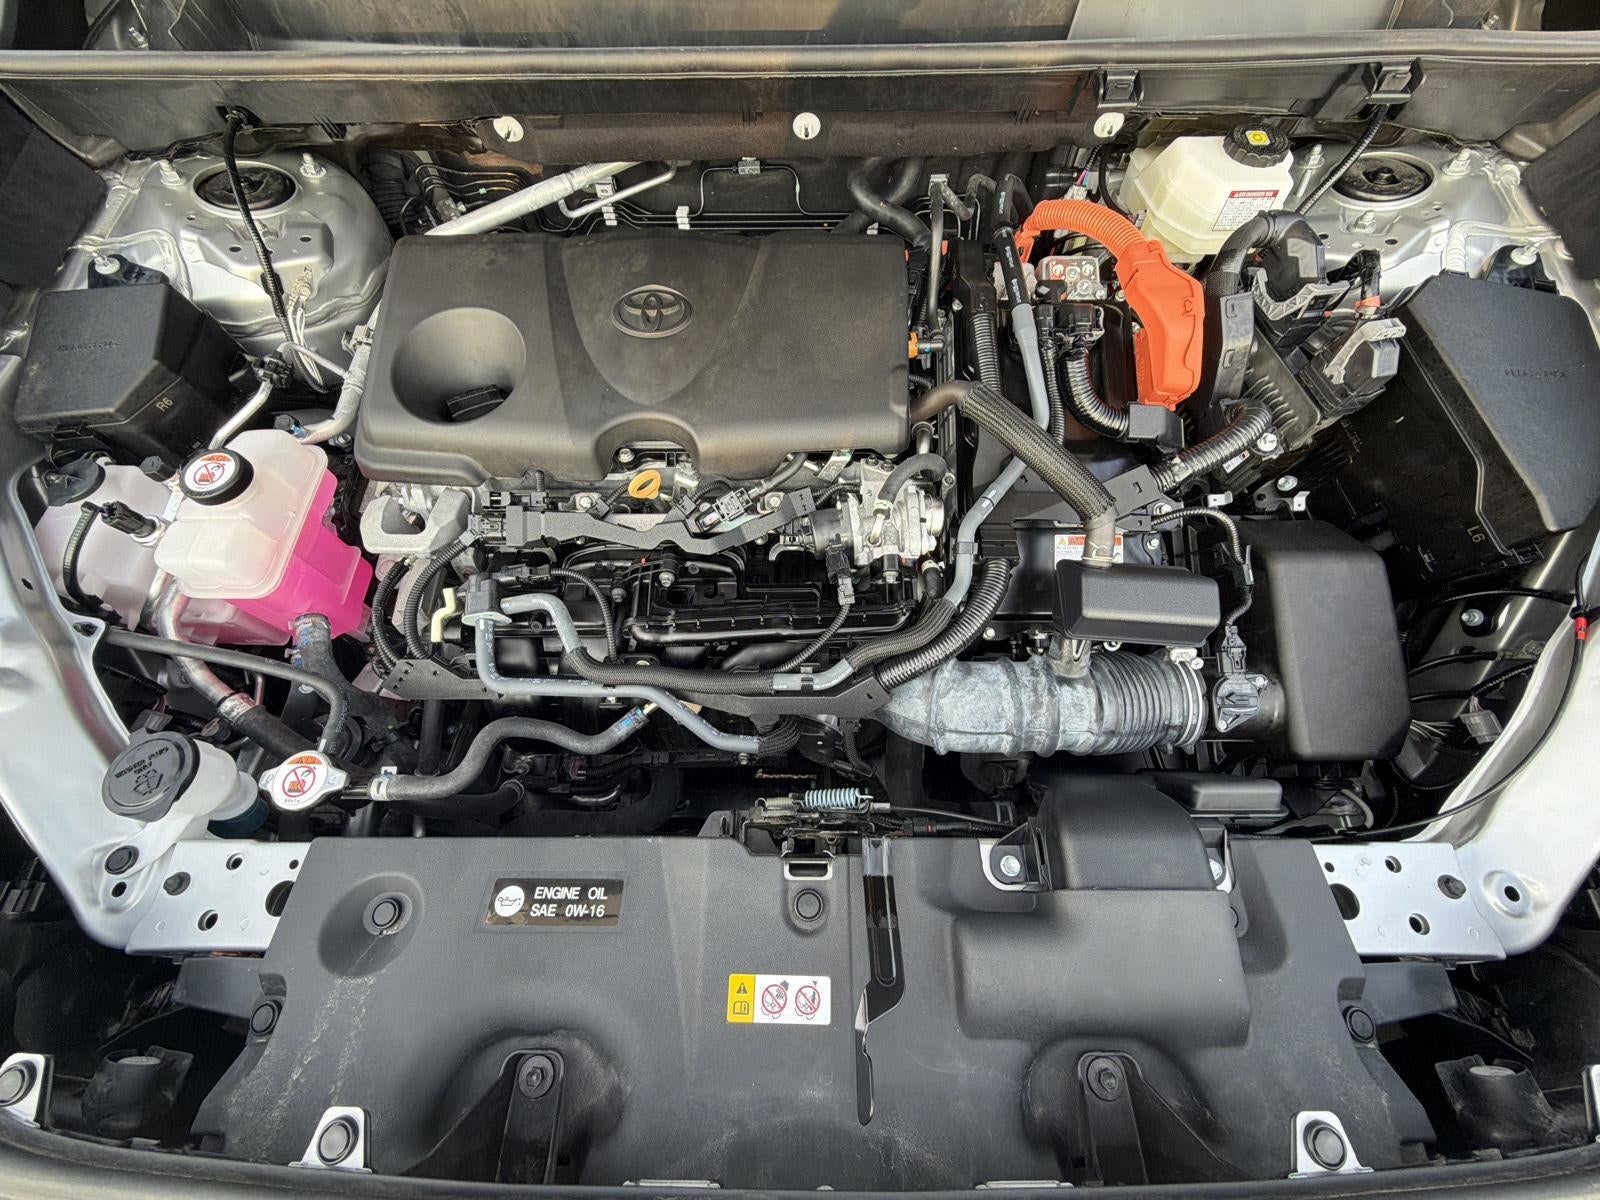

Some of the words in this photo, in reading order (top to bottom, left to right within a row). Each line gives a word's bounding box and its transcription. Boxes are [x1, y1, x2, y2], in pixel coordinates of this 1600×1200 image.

[155, 397, 173, 412] R6
[1467, 525, 1485, 542] L6
[533, 886, 581, 900] ENGINE
[587, 886, 608, 900] OIL
[530, 903, 557, 917] SAE
[565, 904, 606, 917] 0W-16
